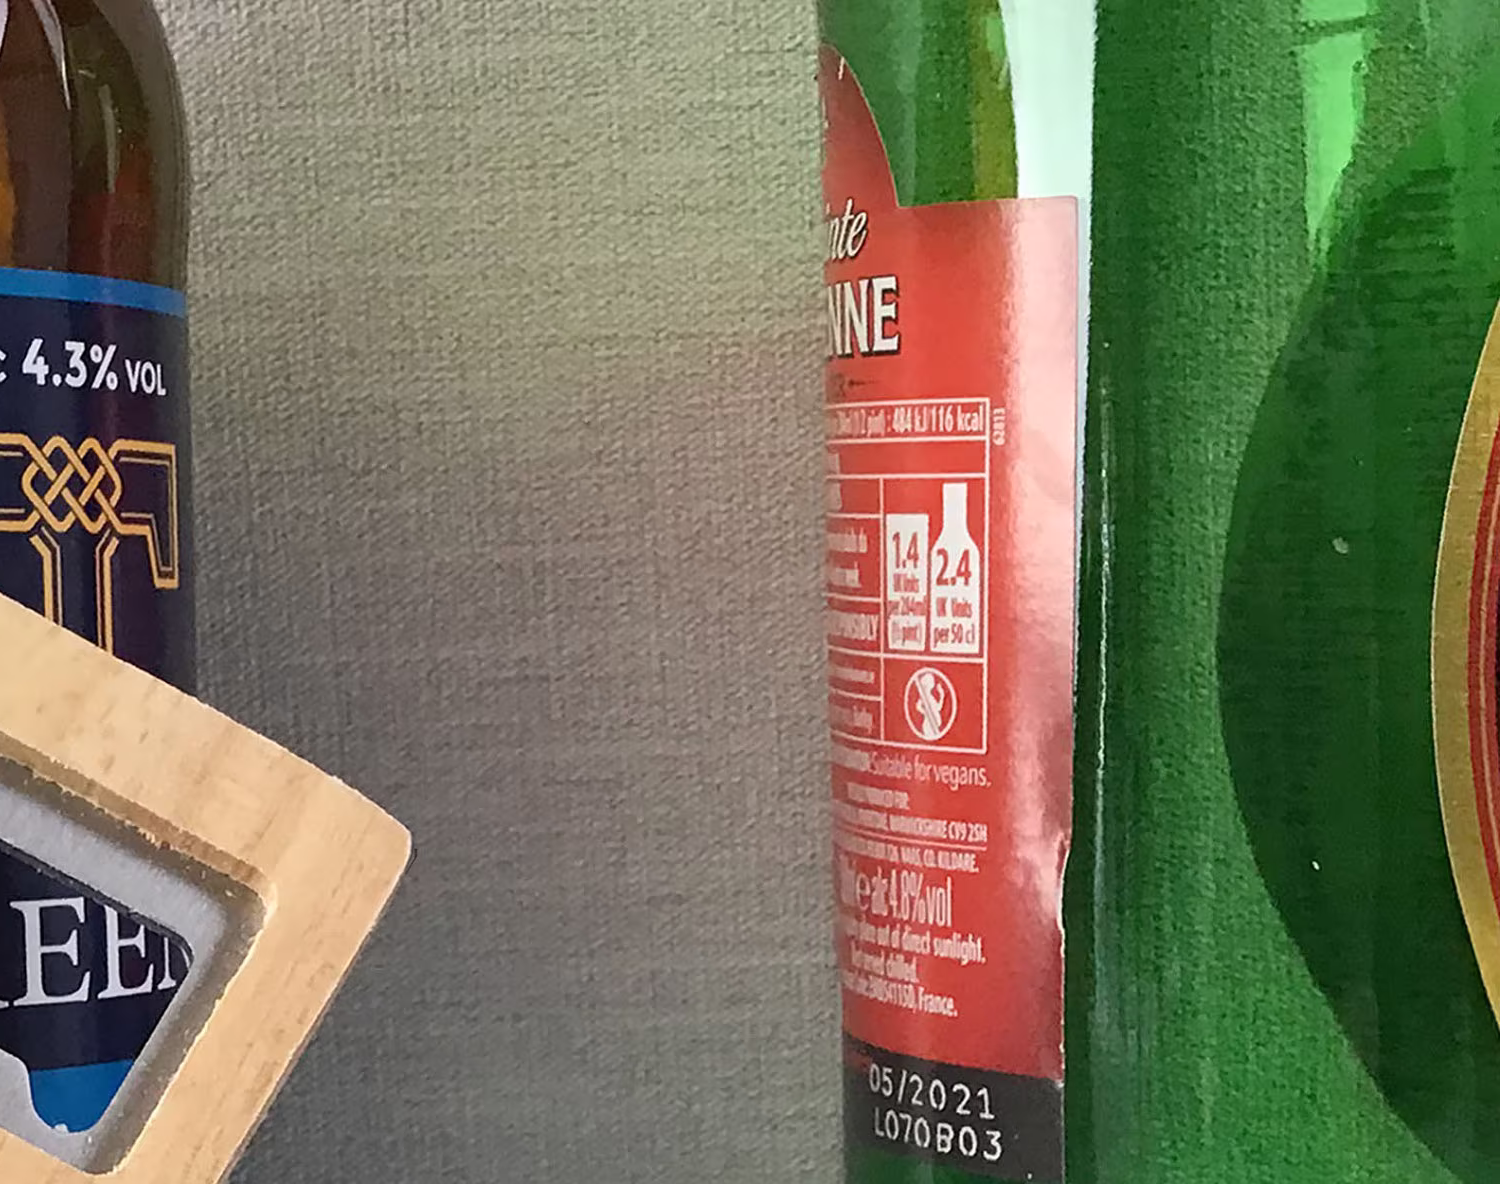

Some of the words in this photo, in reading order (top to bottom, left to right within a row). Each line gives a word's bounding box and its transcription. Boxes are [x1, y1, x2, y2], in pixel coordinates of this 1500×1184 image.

[22, 338, 118, 390] 4.3%
[125, 358, 167, 396] VOL
[957, 404, 984, 432] kcal
[892, 531, 919, 569] 1.4
[936, 548, 972, 586] 2.4
[869, 1063, 995, 1120] 05/2021
[874, 1107, 1002, 1161] L070B03
